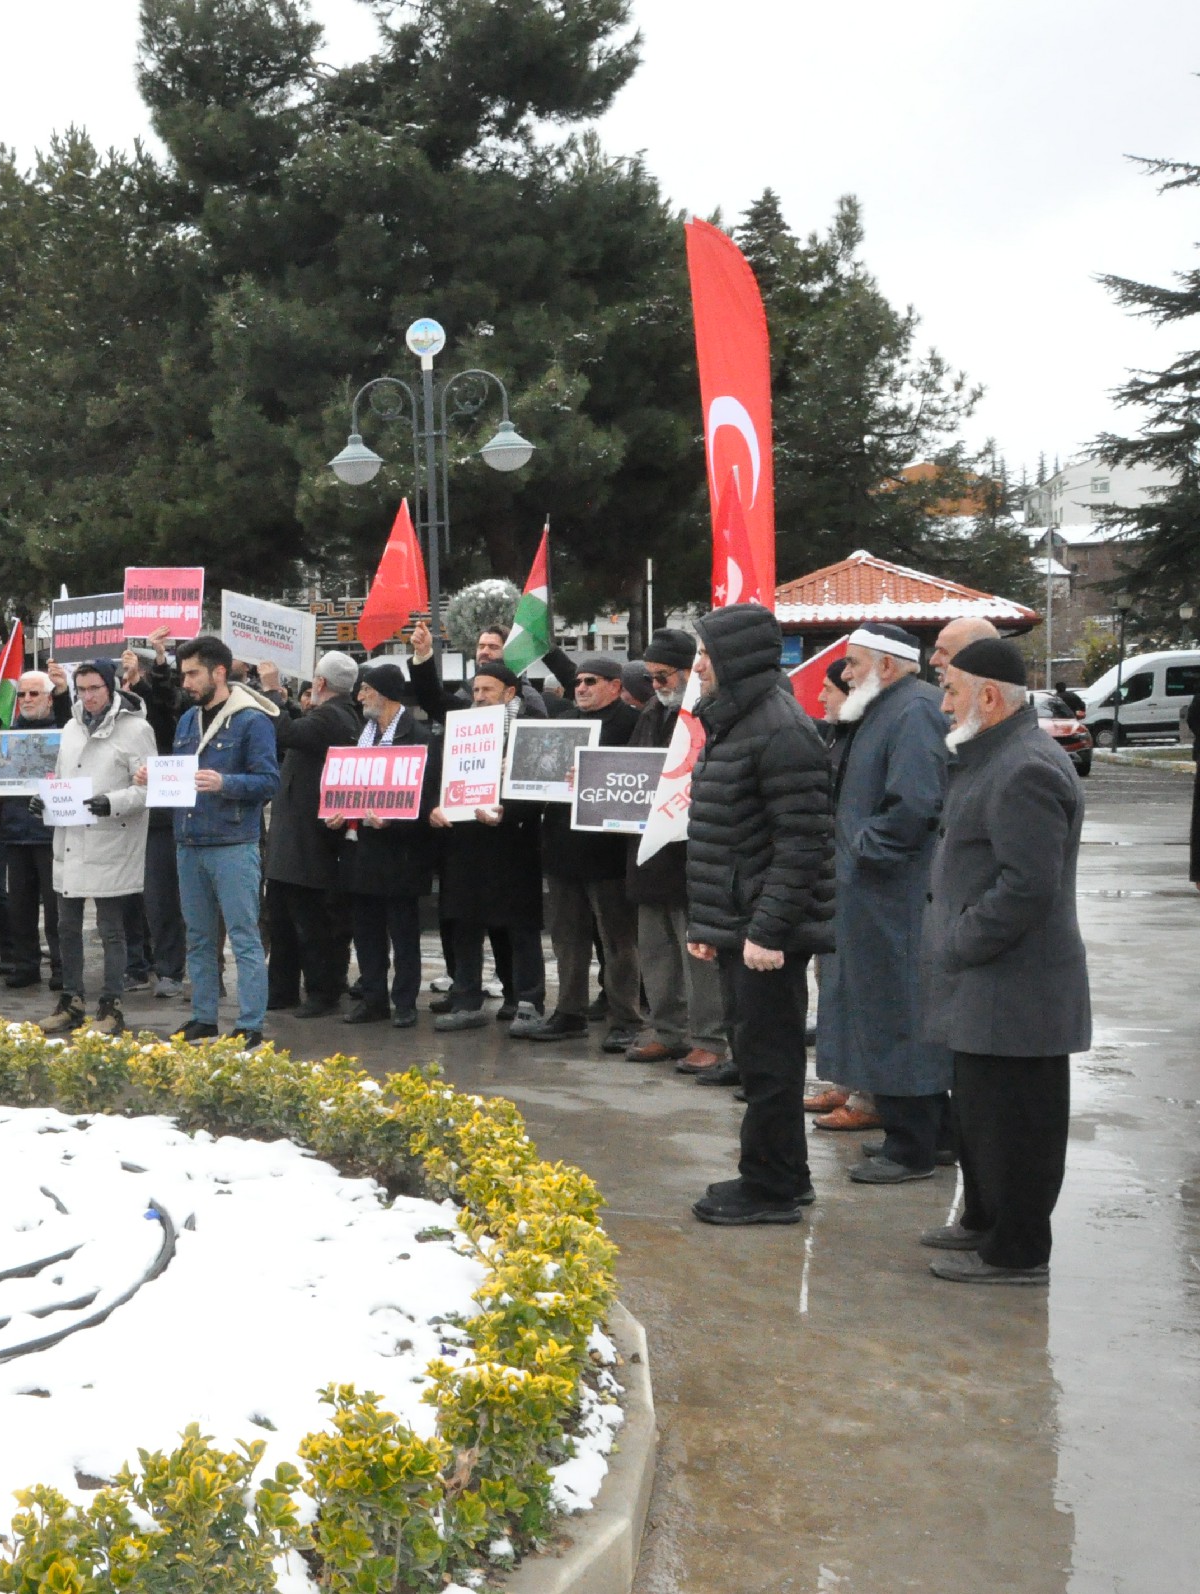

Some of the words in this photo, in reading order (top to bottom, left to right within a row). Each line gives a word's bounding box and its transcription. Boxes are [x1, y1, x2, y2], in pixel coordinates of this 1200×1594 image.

[455, 723, 494, 738] İSLAM
[325, 757, 387, 786] BANA
[391, 756, 422, 786] NE
[459, 756, 486, 774] İÇİN
[605, 772, 649, 789] STOP
[325, 786, 415, 809] AMERİKADAN
[580, 788, 657, 804] GENOCID
[52, 809, 77, 817] TRUMP
